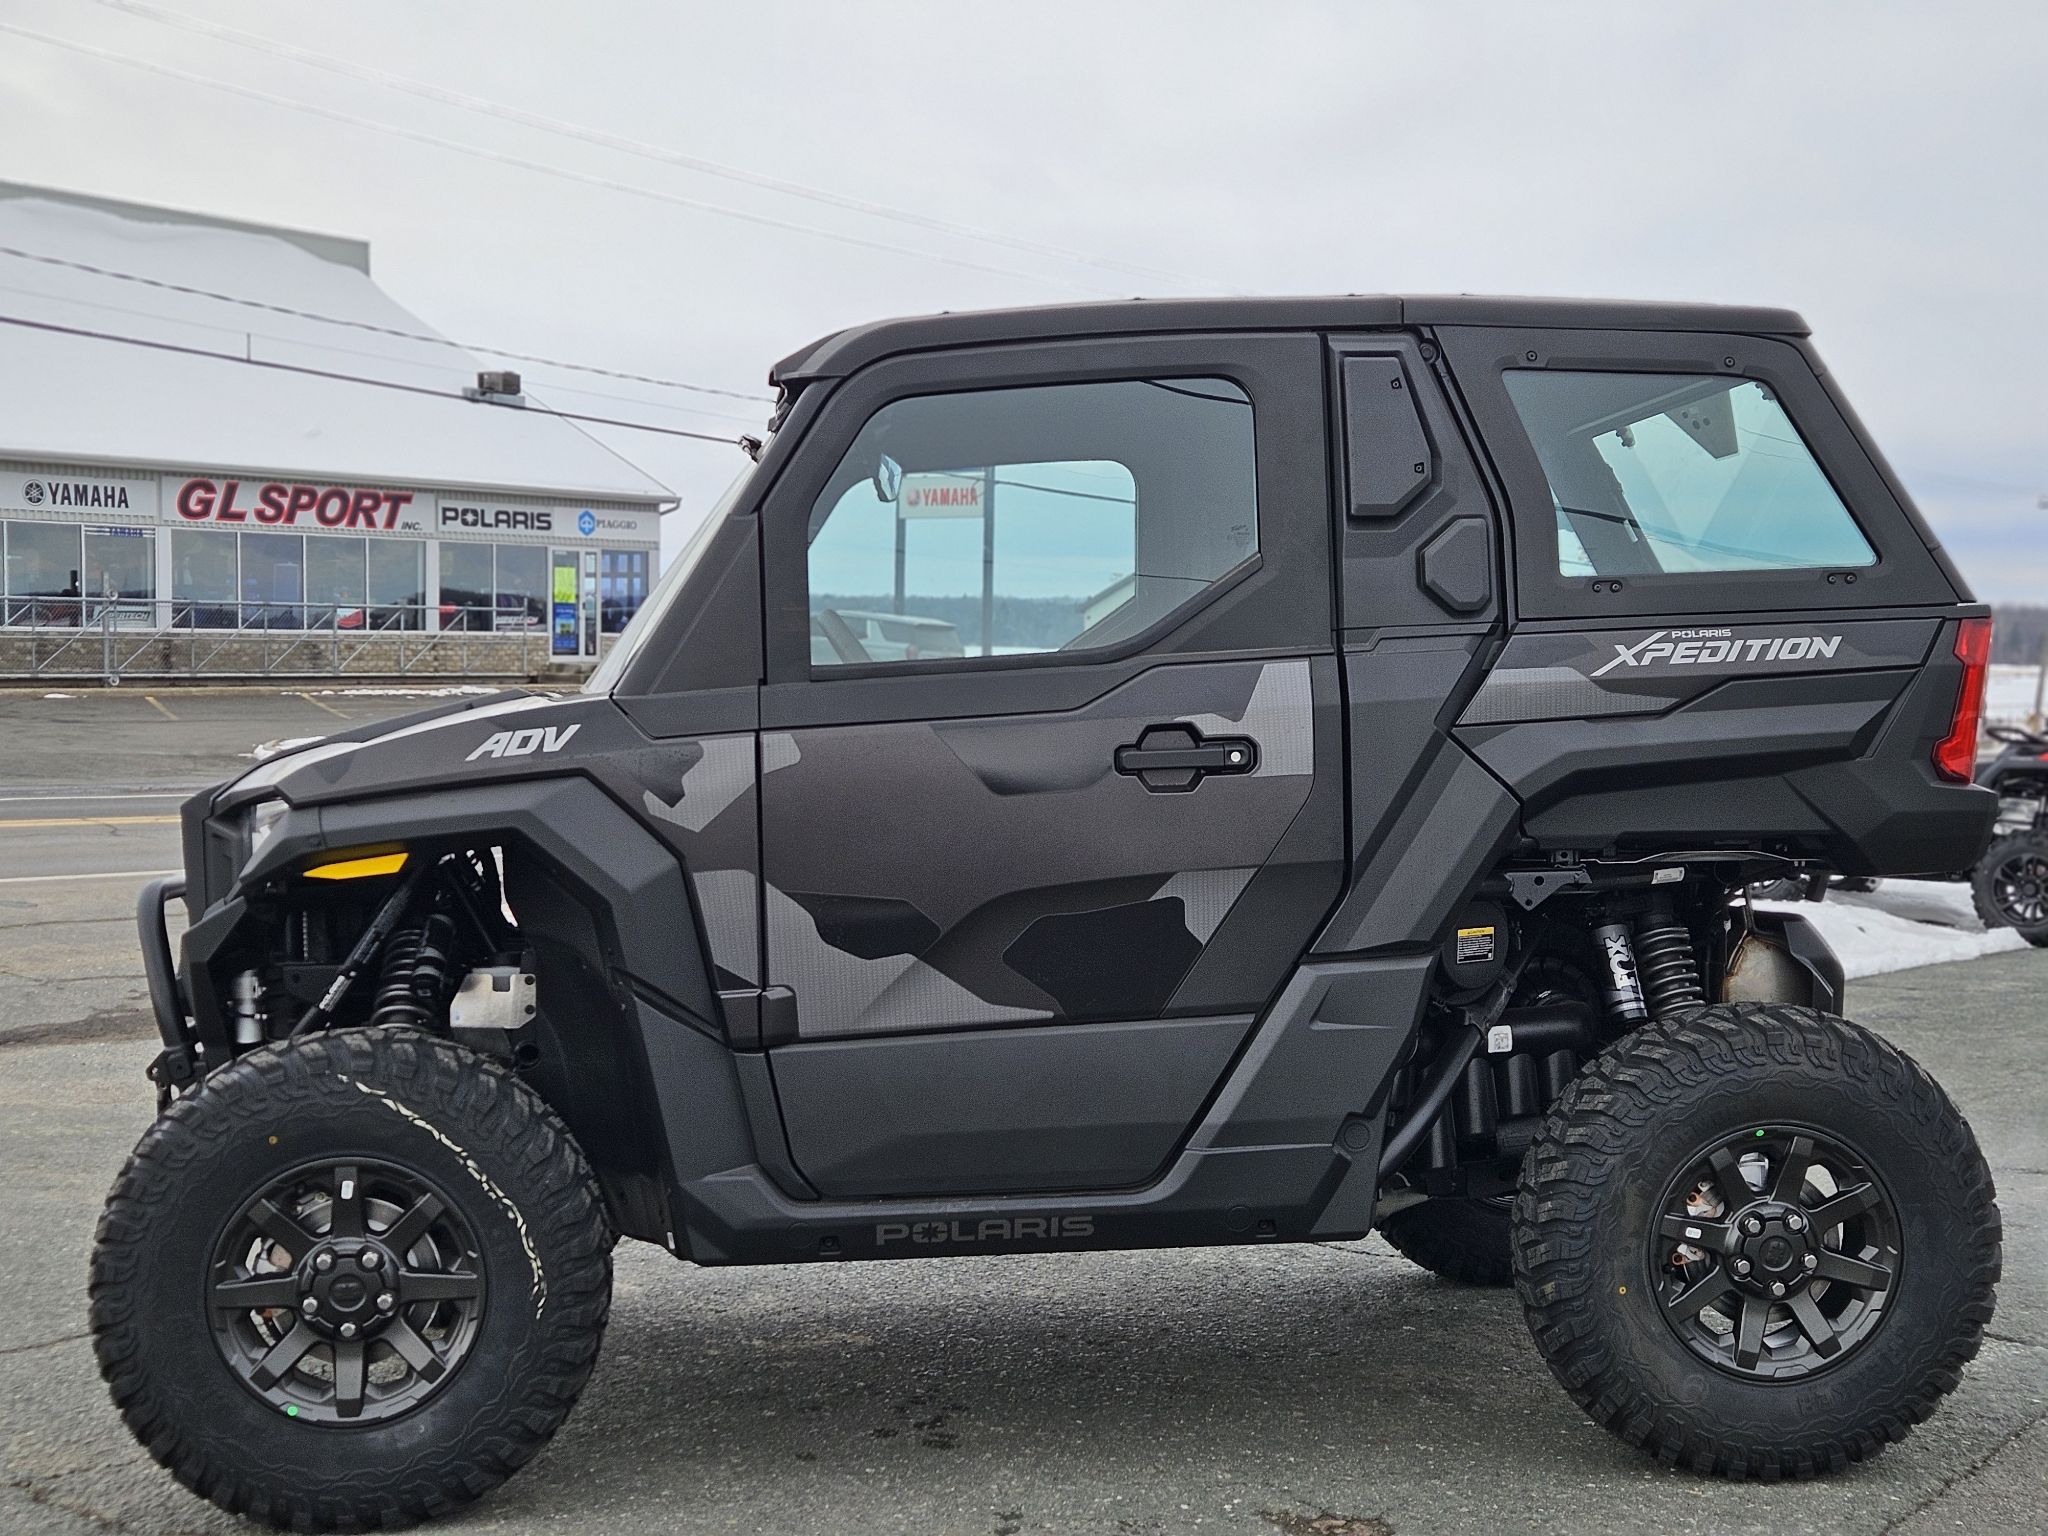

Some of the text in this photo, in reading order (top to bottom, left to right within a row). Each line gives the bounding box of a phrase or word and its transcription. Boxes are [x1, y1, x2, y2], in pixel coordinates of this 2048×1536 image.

[47, 482, 129, 509] YAMAHA
[253, 482, 414, 530] SPORT
[401, 521, 423, 531] INC.
[922, 487, 978, 506] YAMAHA
[441, 506, 552, 531] POLARIS
[1671, 629, 1732, 639] POLARIS
[1590, 631, 1843, 677] XPEDITION
[464, 723, 582, 762] ADV
[1603, 935, 1637, 990] FOX
[875, 1215, 1095, 1246] POLARIS
